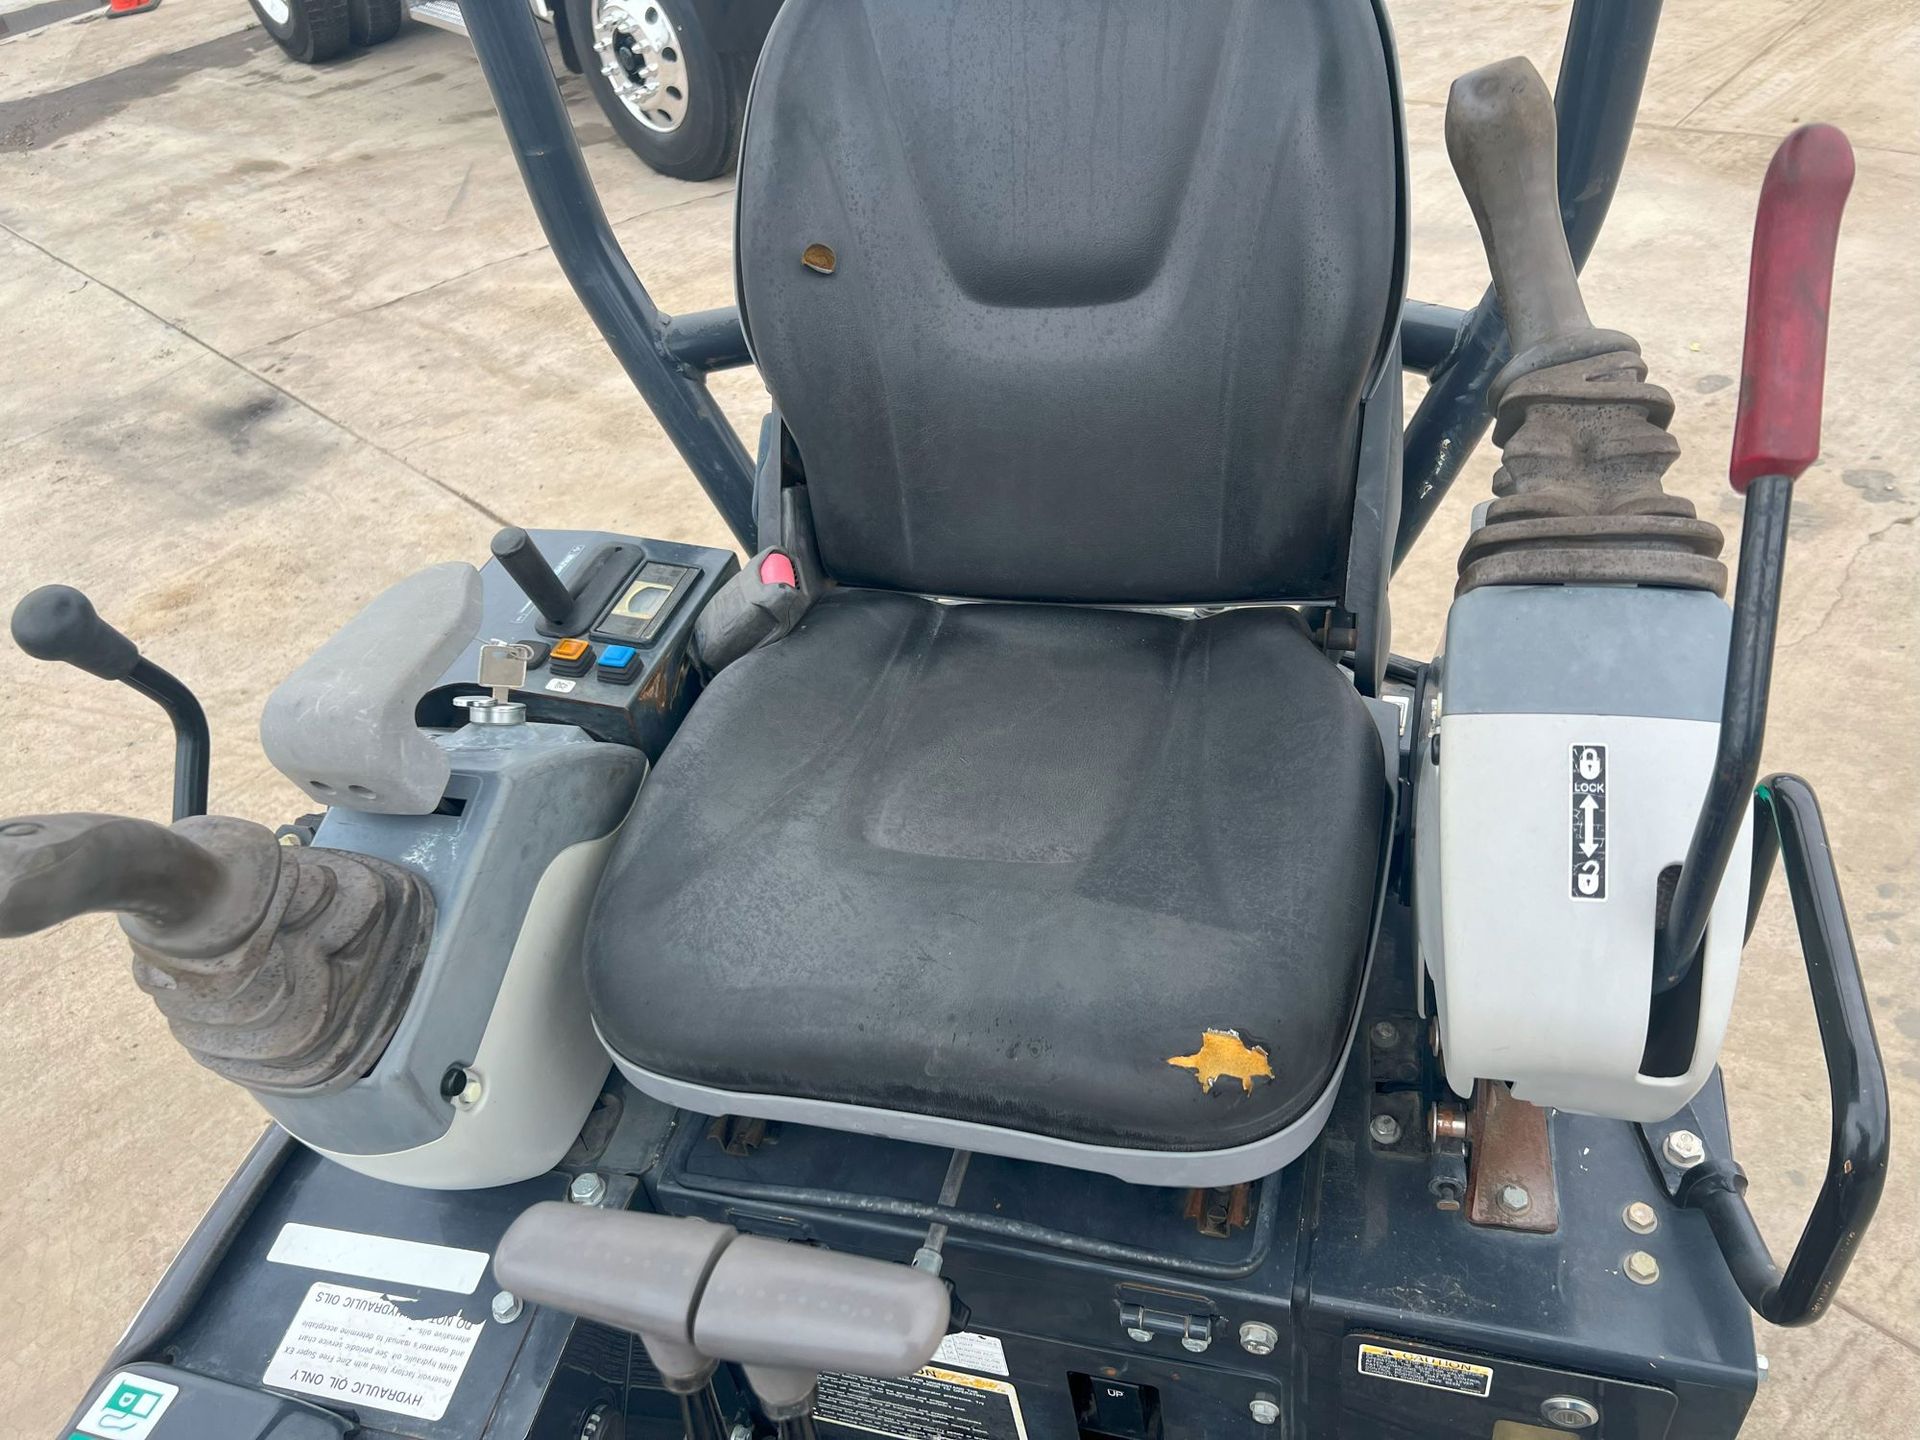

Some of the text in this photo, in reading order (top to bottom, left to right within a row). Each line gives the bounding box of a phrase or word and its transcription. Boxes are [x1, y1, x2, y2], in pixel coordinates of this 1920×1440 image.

[1574, 783, 1605, 793] LOCK
[315, 1292, 340, 1305] OILS
[302, 1320, 338, 1333] acceptable
[456, 1318, 473, 1330] DO
[298, 1335, 317, 1343] chart
[340, 1328, 374, 1341] determine
[434, 1331, 471, 1344] alternative
[318, 1338, 343, 1348] service
[384, 1337, 411, 1347] manual
[344, 1344, 375, 1354] periodic
[414, 1343, 448, 1354] operator's
[450, 1349, 465, 1357] and
[375, 1350, 389, 1359] See
[284, 1346, 452, 1387] Reservoir factory filled with Zinc Free Super EX
[404, 1355, 436, 1369] hydraulic
[1403, 1353, 1472, 1370] CAUTION
[290, 1370, 422, 1406] HYDRAULIC OIL ONLY
[1107, 1388, 1124, 1398] UP
